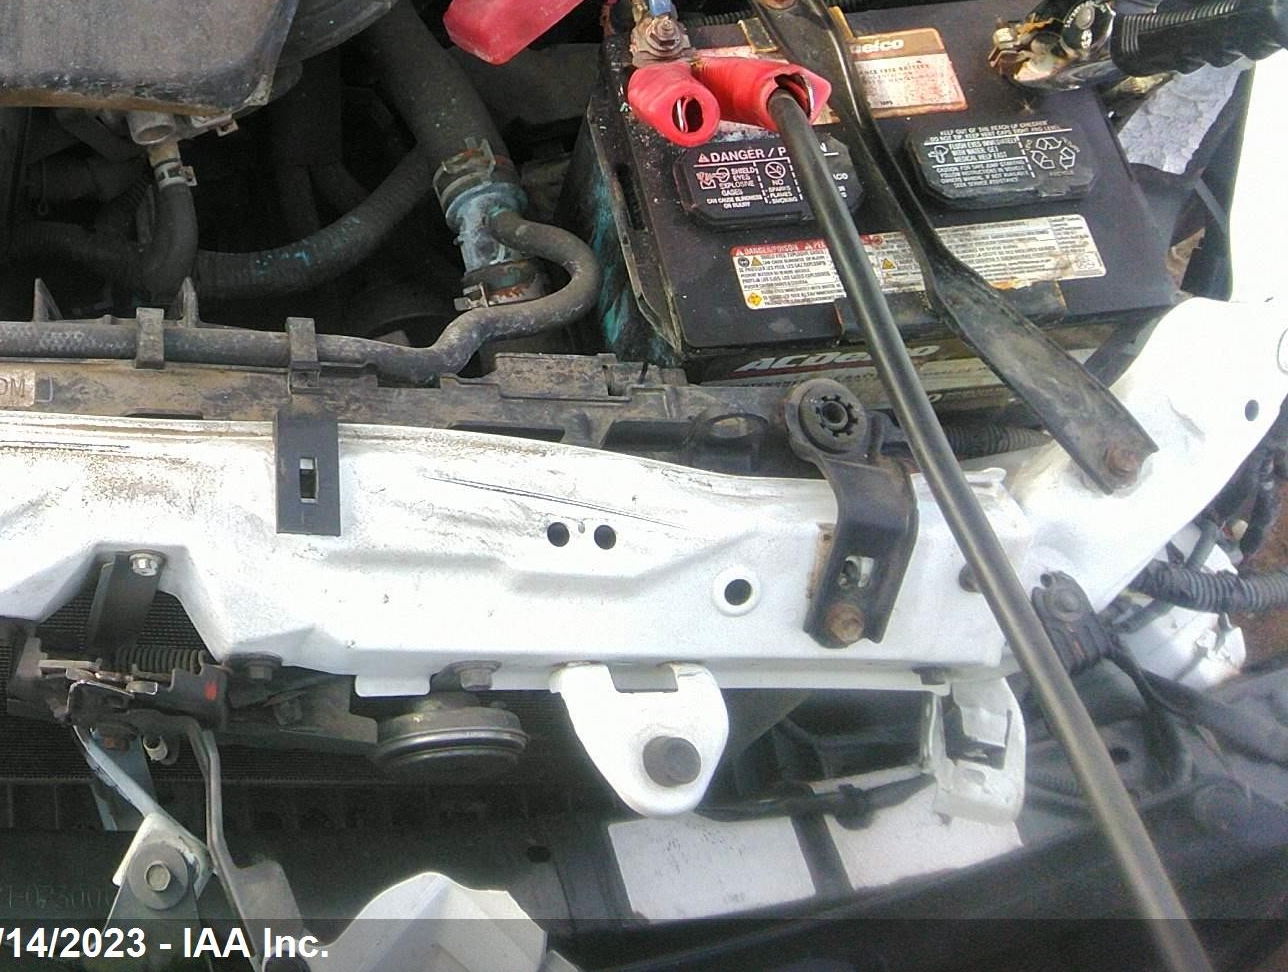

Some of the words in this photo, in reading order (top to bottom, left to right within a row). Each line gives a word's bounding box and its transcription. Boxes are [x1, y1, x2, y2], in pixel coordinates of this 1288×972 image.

[851, 37, 904, 54] elco
[710, 148, 765, 163] DANGER
[733, 344, 941, 373] ACDeo
